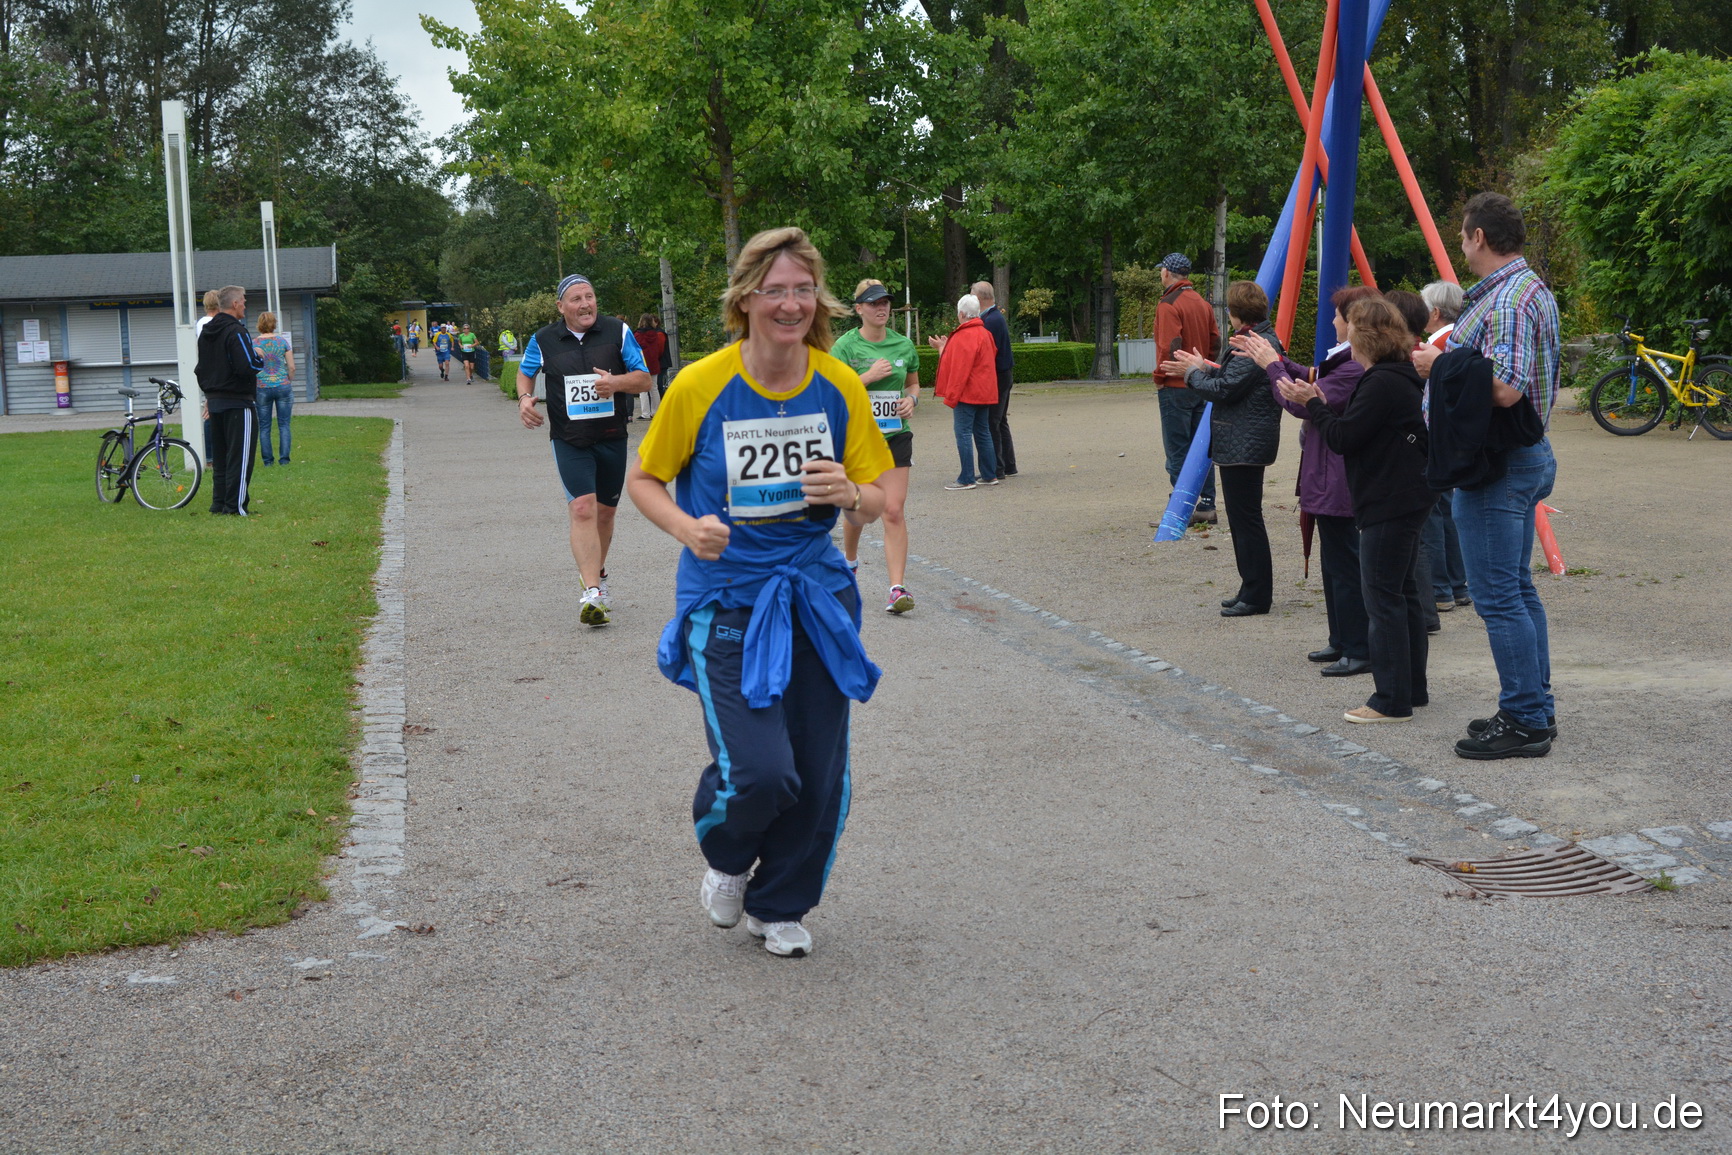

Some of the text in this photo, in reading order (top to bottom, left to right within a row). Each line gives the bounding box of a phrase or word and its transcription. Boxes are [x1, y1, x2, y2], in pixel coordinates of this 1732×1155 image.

[571, 385, 610, 402] 253
[583, 405, 600, 413] Hans
[872, 401, 897, 417] 309
[726, 425, 815, 440] PARTL Neumarkt
[738, 438, 823, 480] 2265
